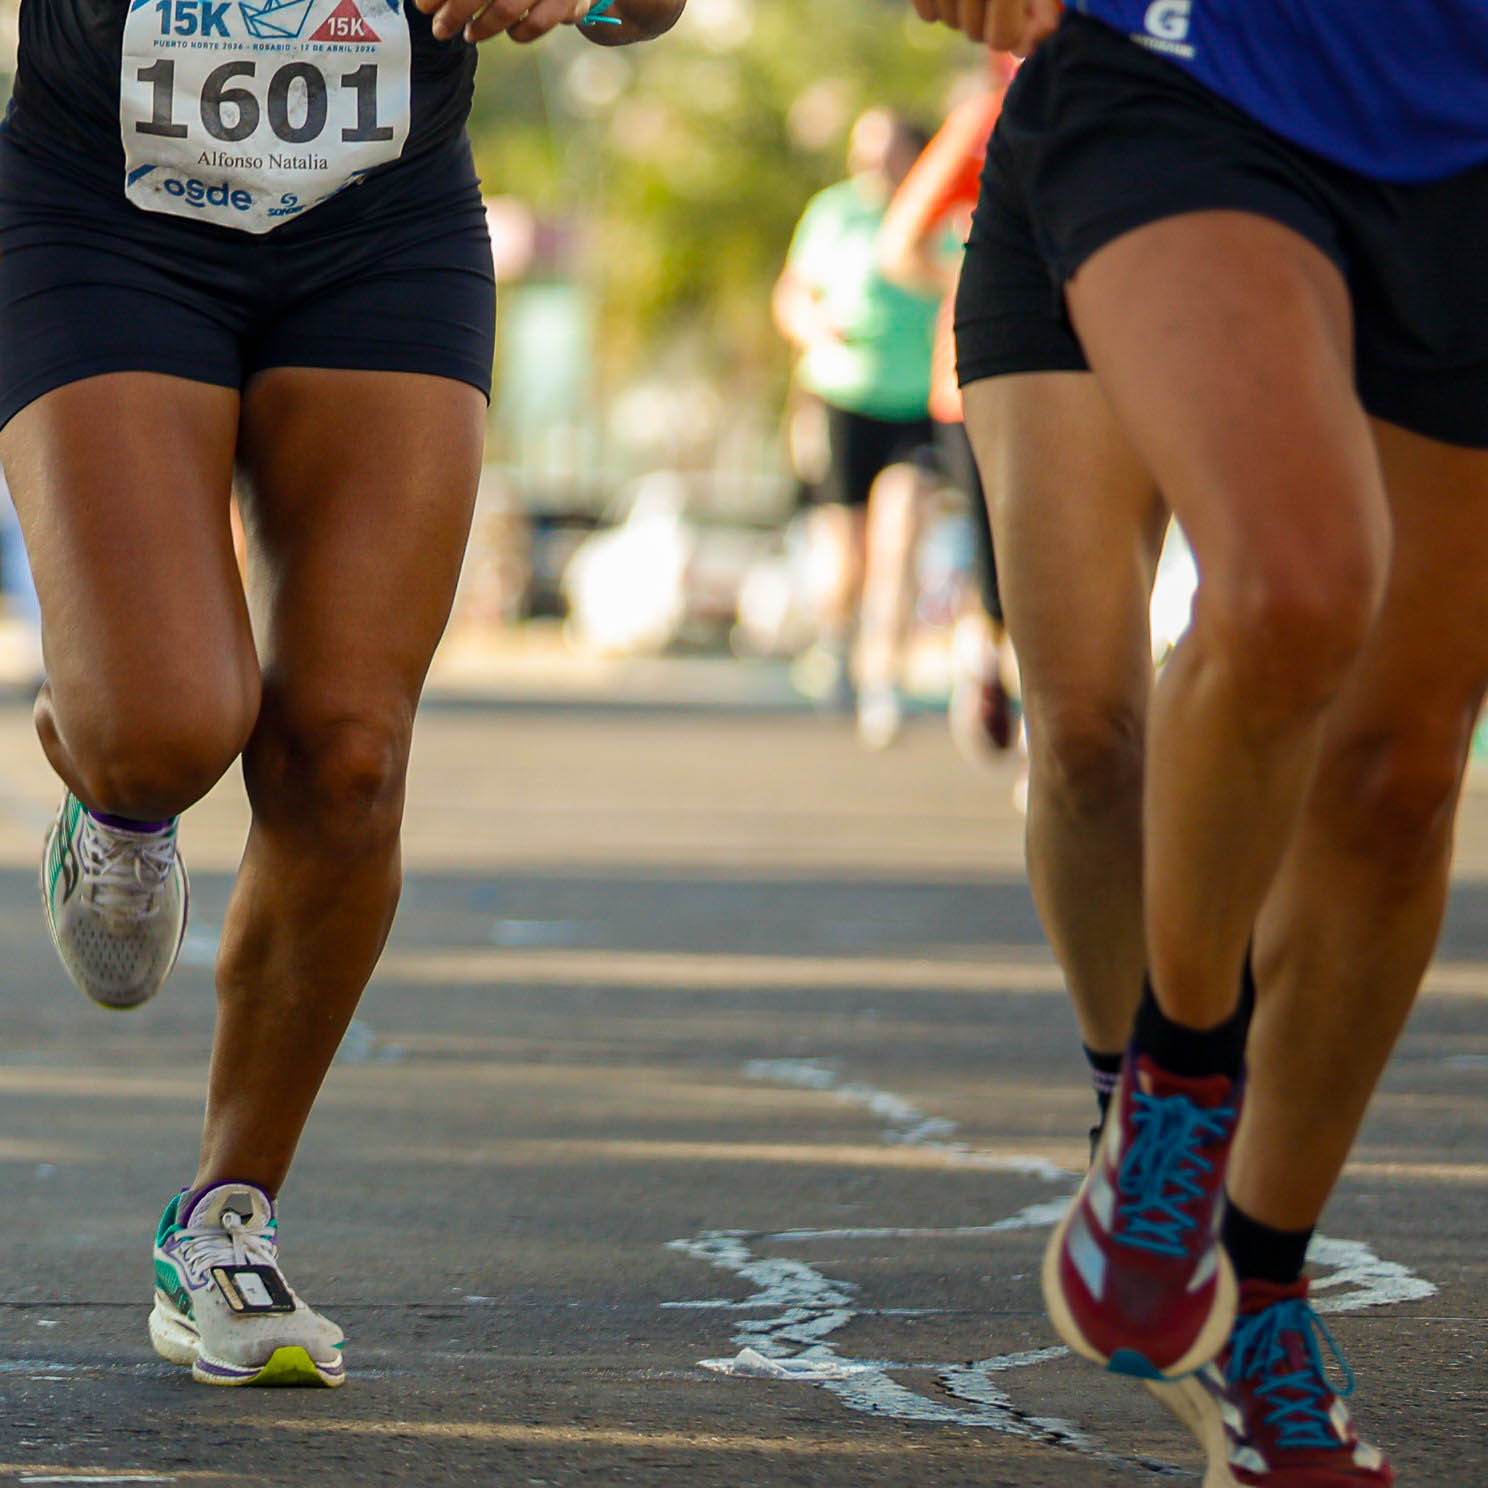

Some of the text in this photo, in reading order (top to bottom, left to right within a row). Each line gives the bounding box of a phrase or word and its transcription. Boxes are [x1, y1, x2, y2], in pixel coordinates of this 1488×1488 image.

[327, 16, 366, 37] 15K
[312, 44, 323, 52] DE
[135, 58, 394, 145] 1601
[197, 151, 329, 171] Alfonso Natalia
[164, 178, 252, 211] osde
